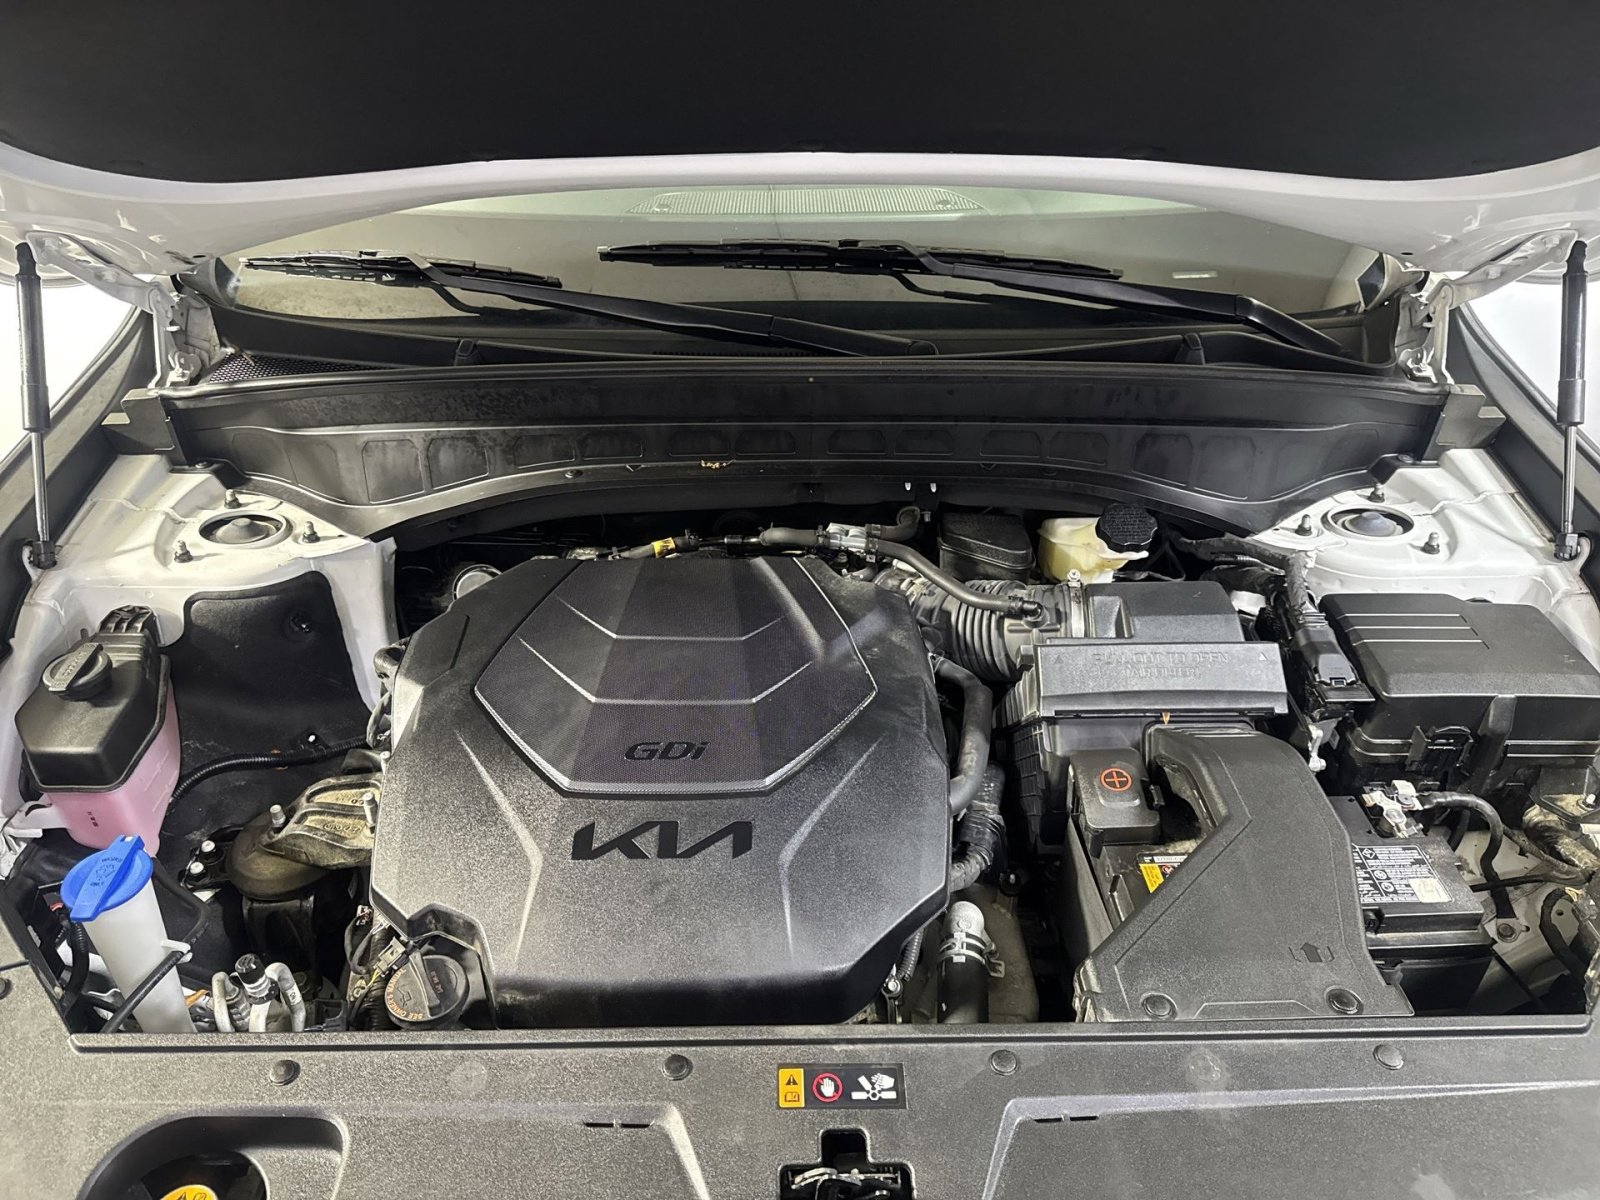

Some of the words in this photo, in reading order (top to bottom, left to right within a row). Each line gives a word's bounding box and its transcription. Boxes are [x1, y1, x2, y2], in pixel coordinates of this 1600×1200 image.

[1133, 652, 1163, 665] OUT
[1166, 651, 1186, 664] TO
[1190, 651, 1230, 664] OPEN
[624, 742, 710, 761] GDi
[571, 820, 753, 860] KIA
[408, 1012, 424, 1020] SEE
